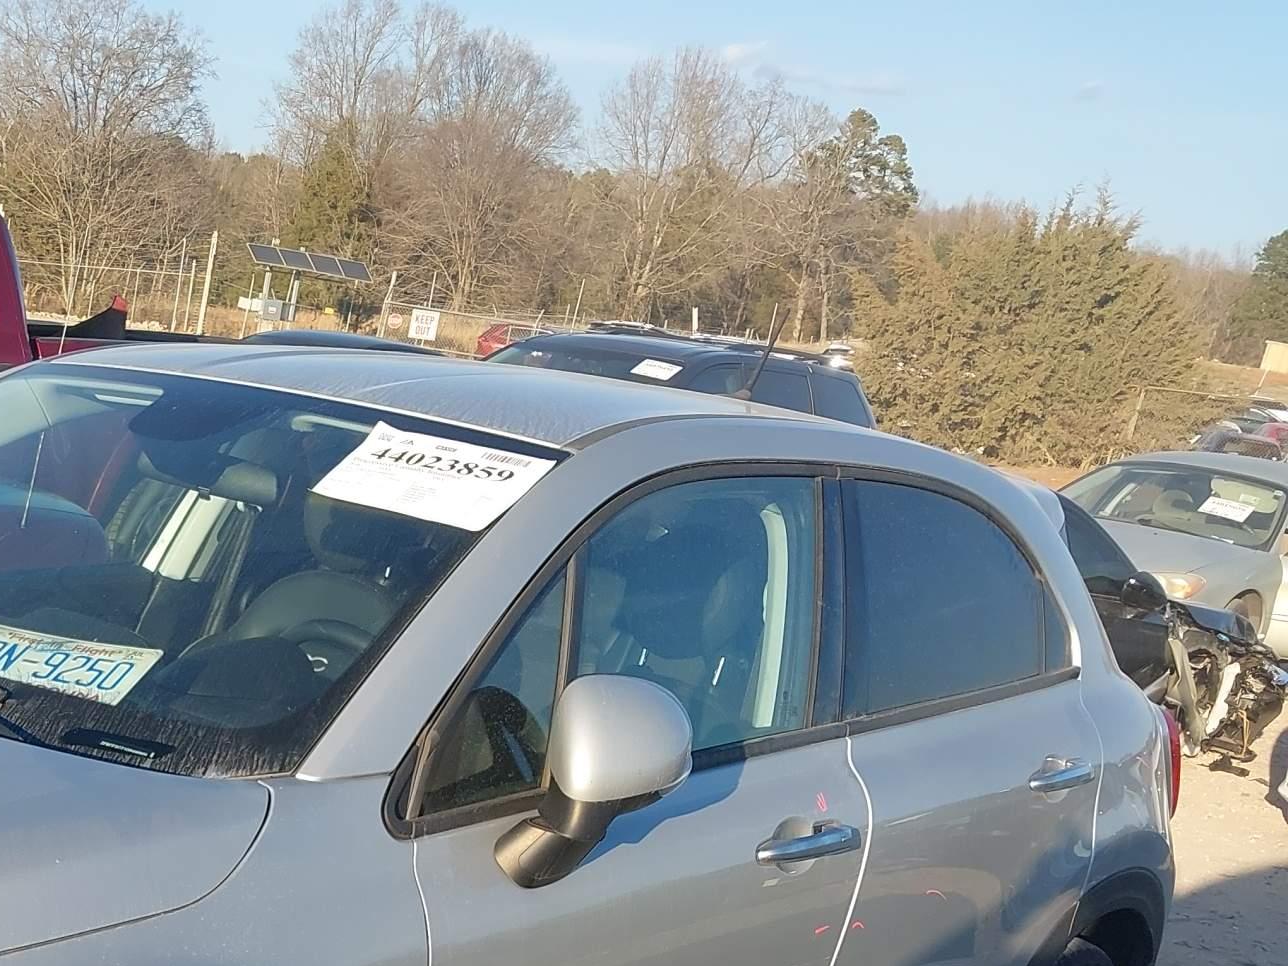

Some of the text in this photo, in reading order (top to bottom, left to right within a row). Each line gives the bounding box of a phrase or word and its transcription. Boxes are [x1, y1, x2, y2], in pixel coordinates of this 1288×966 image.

[415, 313, 435, 325] KEEP
[415, 325, 431, 336] OUT
[370, 447, 515, 482] 44023859
